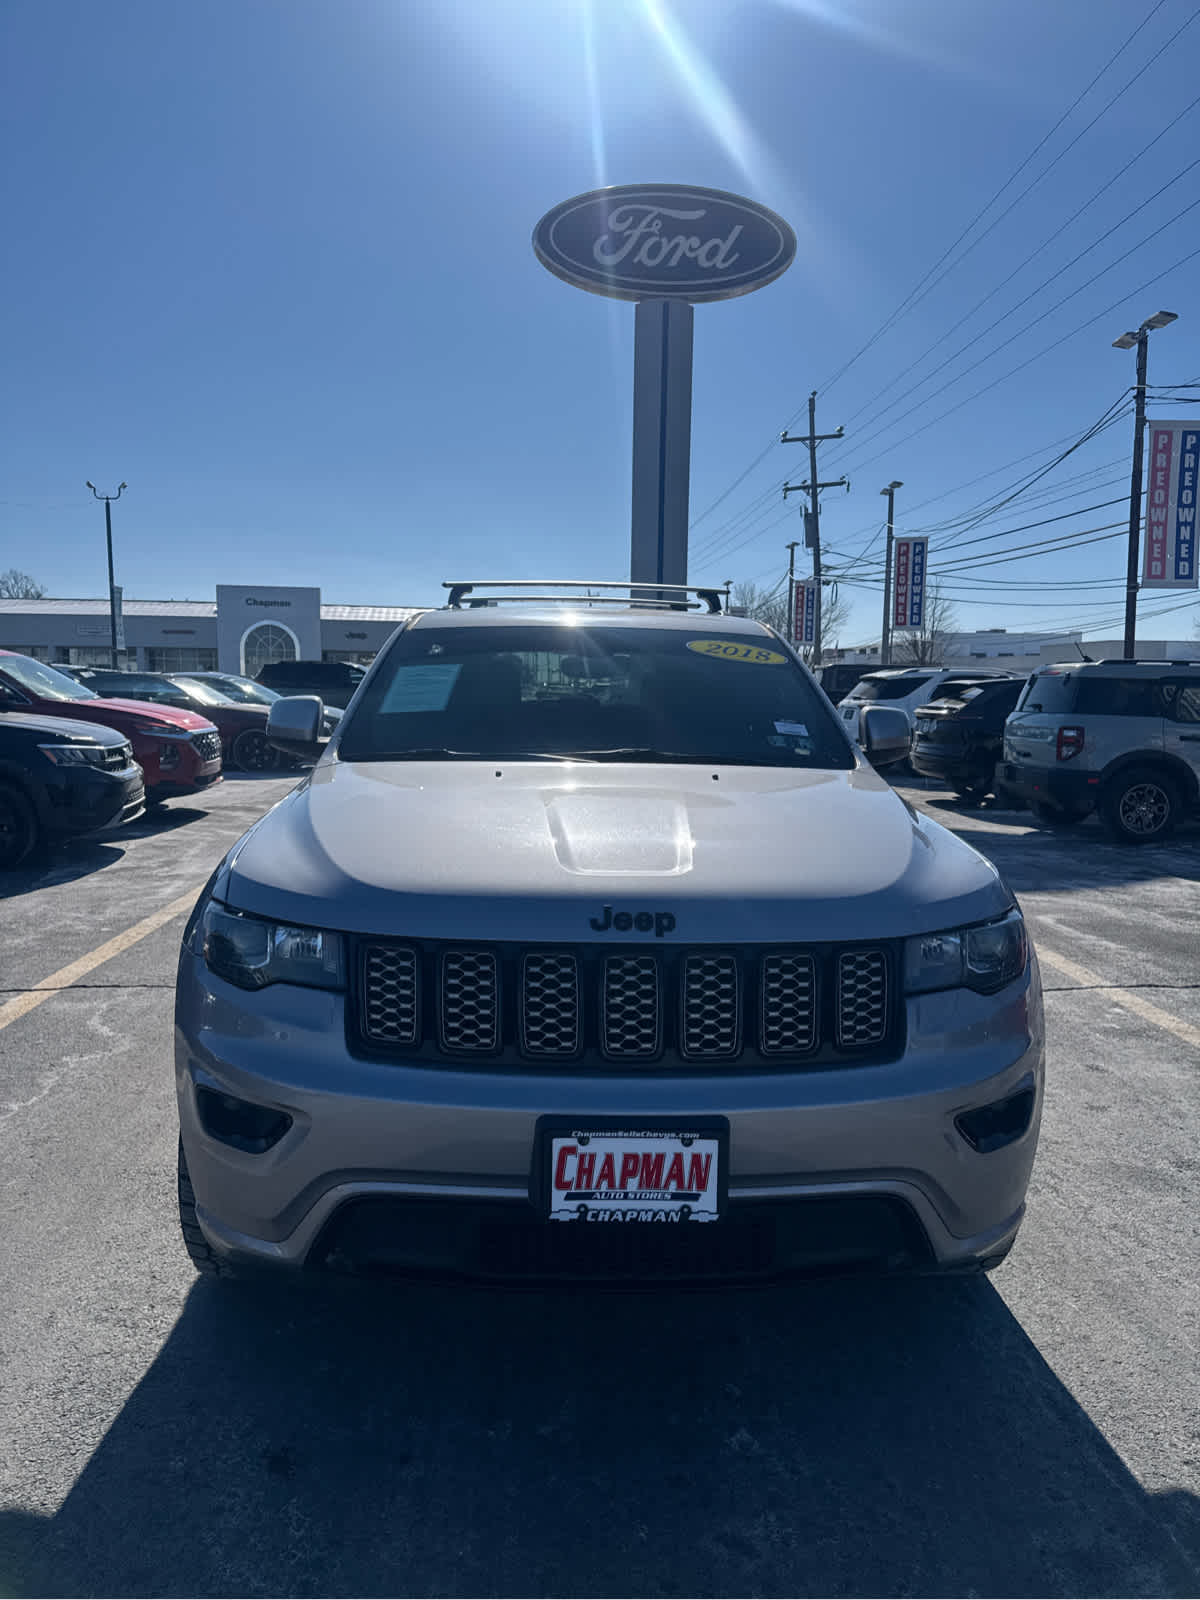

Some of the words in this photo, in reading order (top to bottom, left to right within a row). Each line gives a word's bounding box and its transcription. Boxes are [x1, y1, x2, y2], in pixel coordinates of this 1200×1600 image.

[593, 204, 744, 269] Ford
[1151, 433, 1169, 576] PREOWNED
[1178, 433, 1197, 576] PREOWNED
[245, 597, 292, 608] Chapman
[705, 643, 771, 661] 2018
[588, 904, 676, 938] Jeep
[554, 1146, 713, 1192] CHAPMAN
[592, 1192, 624, 1200] AUTO
[627, 1192, 672, 1200] STORES
[586, 1208, 682, 1222] CHAPMAN
